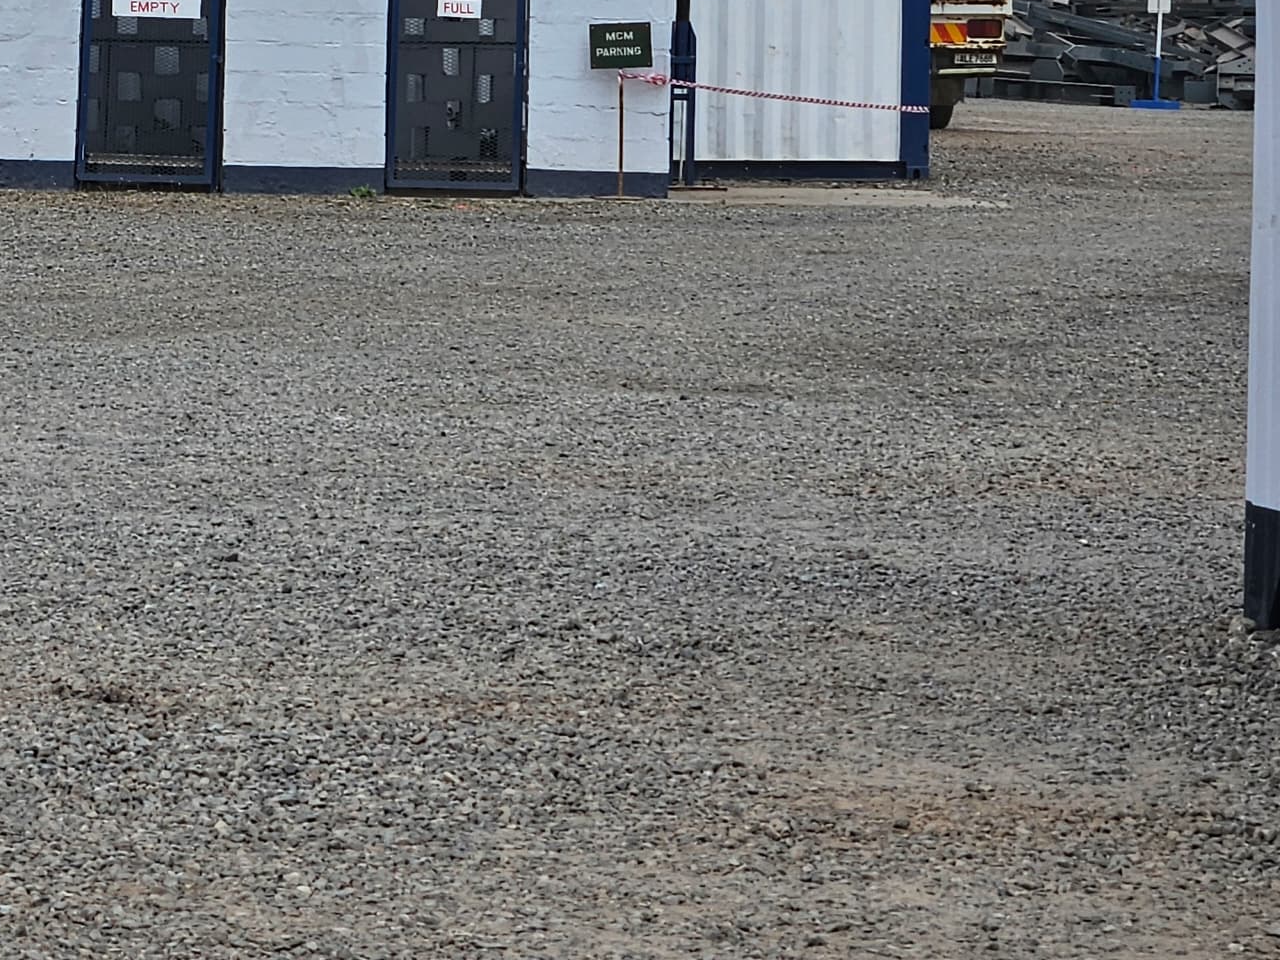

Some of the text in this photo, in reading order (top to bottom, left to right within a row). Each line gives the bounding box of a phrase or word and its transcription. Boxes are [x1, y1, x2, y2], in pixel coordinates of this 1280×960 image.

[130, 1, 180, 14] EMPTY
[443, 2, 474, 14] FULL
[605, 31, 634, 41] MCM
[595, 46, 642, 57] PARKING
